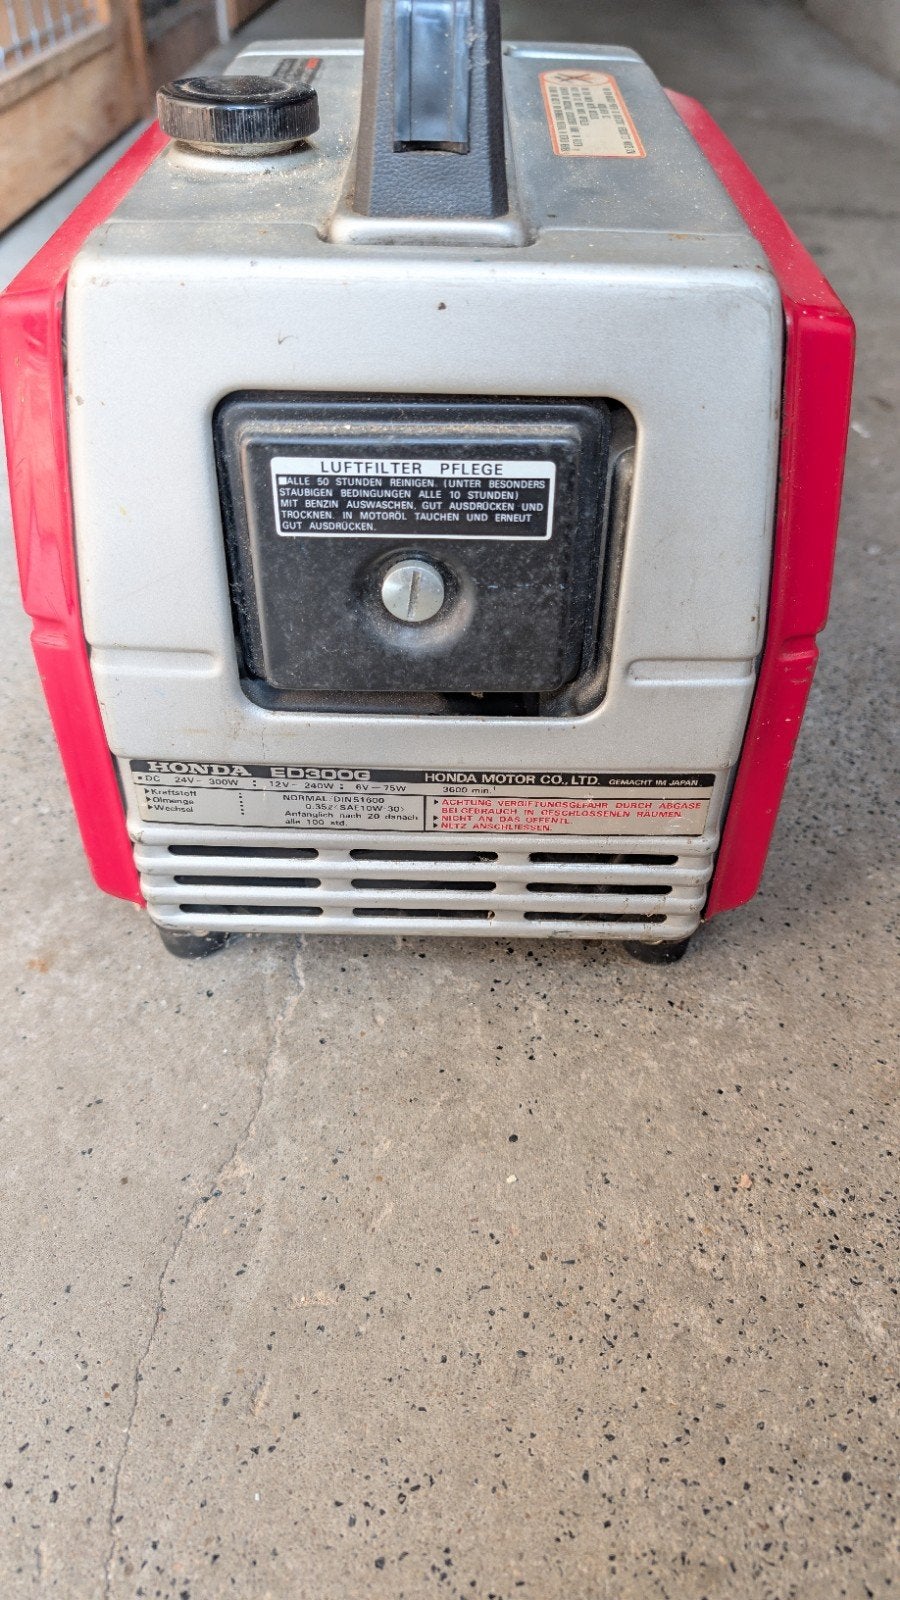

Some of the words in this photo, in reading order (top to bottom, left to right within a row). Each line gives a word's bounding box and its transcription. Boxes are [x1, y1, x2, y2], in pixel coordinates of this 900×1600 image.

[321, 461, 422, 474] LUFTFILTER
[440, 463, 503, 475] PFLEGE
[287, 477, 310, 486] ALLE
[317, 478, 329, 486] 50
[335, 478, 382, 487] STUNDEN
[444, 479, 481, 489] (UNTER
[488, 480, 545, 489] BESONDERS
[340, 489, 412, 498] BEDINGUNGEN
[418, 490, 442, 499] ALLE
[449, 491, 461, 499] 10
[467, 491, 519, 500] STUNDEN)
[280, 499, 298, 508] MIT
[305, 500, 339, 508] BENZIN
[421, 502, 443, 510] GUT
[449, 501, 514, 511] AUSDRÜCKEN
[521, 503, 544, 512] UND
[342, 511, 353, 519] IN
[360, 510, 407, 520] MOTORÖL
[414, 512, 460, 521] TAUCHEN
[466, 513, 488, 521] UND
[495, 513, 532, 522] ERNEUT
[282, 521, 302, 530] GUT
[309, 521, 377, 531] AUSDRÜCKEN.
[147, 761, 253, 777] HONDA
[270, 767, 371, 781] ED300G
[425, 773, 477, 783] HONDA
[482, 774, 536, 784] MOTOR
[571, 775, 600, 785] LTD.
[282, 794, 327, 802] NORMAL
[154, 804, 193, 812] Wechsel
[442, 799, 492, 807] ACHTUNG
[498, 800, 608, 809] VERGIFTUNGSGEFAHR
